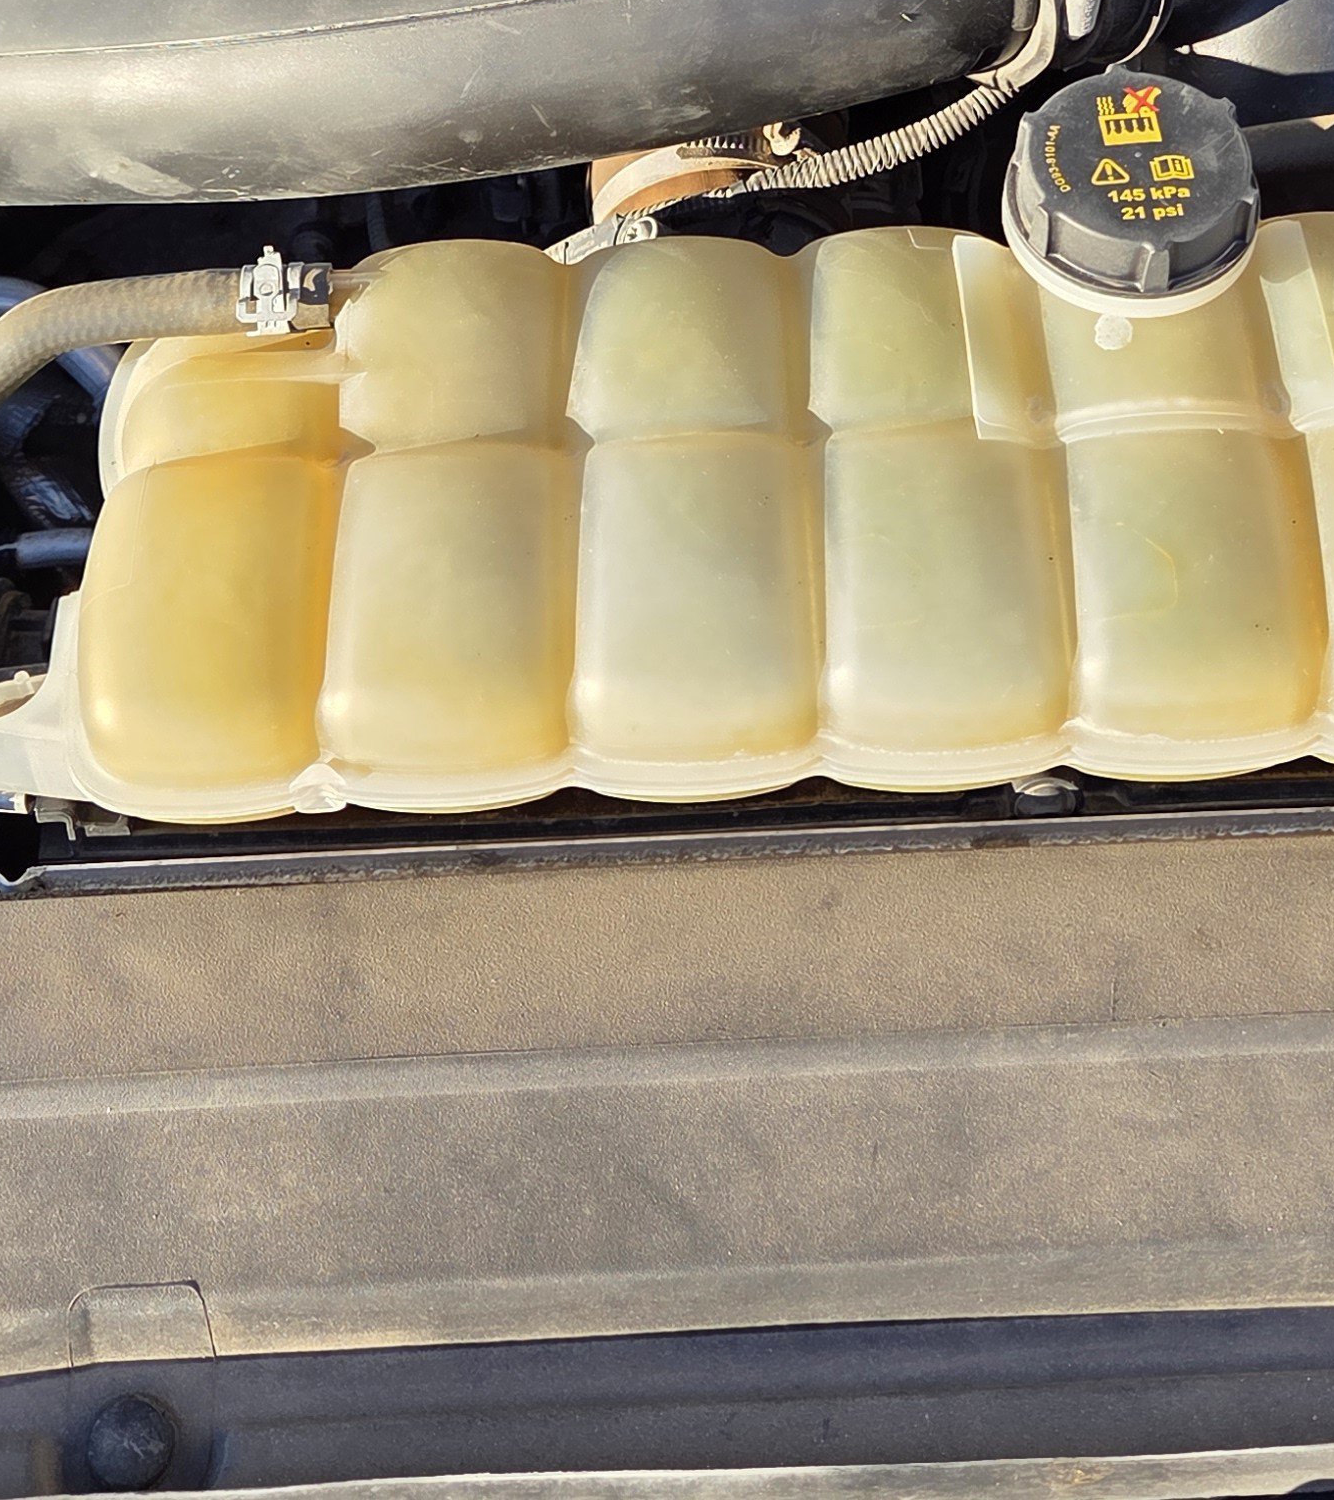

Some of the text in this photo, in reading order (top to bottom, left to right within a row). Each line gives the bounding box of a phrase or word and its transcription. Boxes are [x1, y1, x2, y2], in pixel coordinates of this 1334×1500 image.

[1107, 187, 1190, 203] 145 kPa
[1121, 204, 1185, 221] 21 psi
